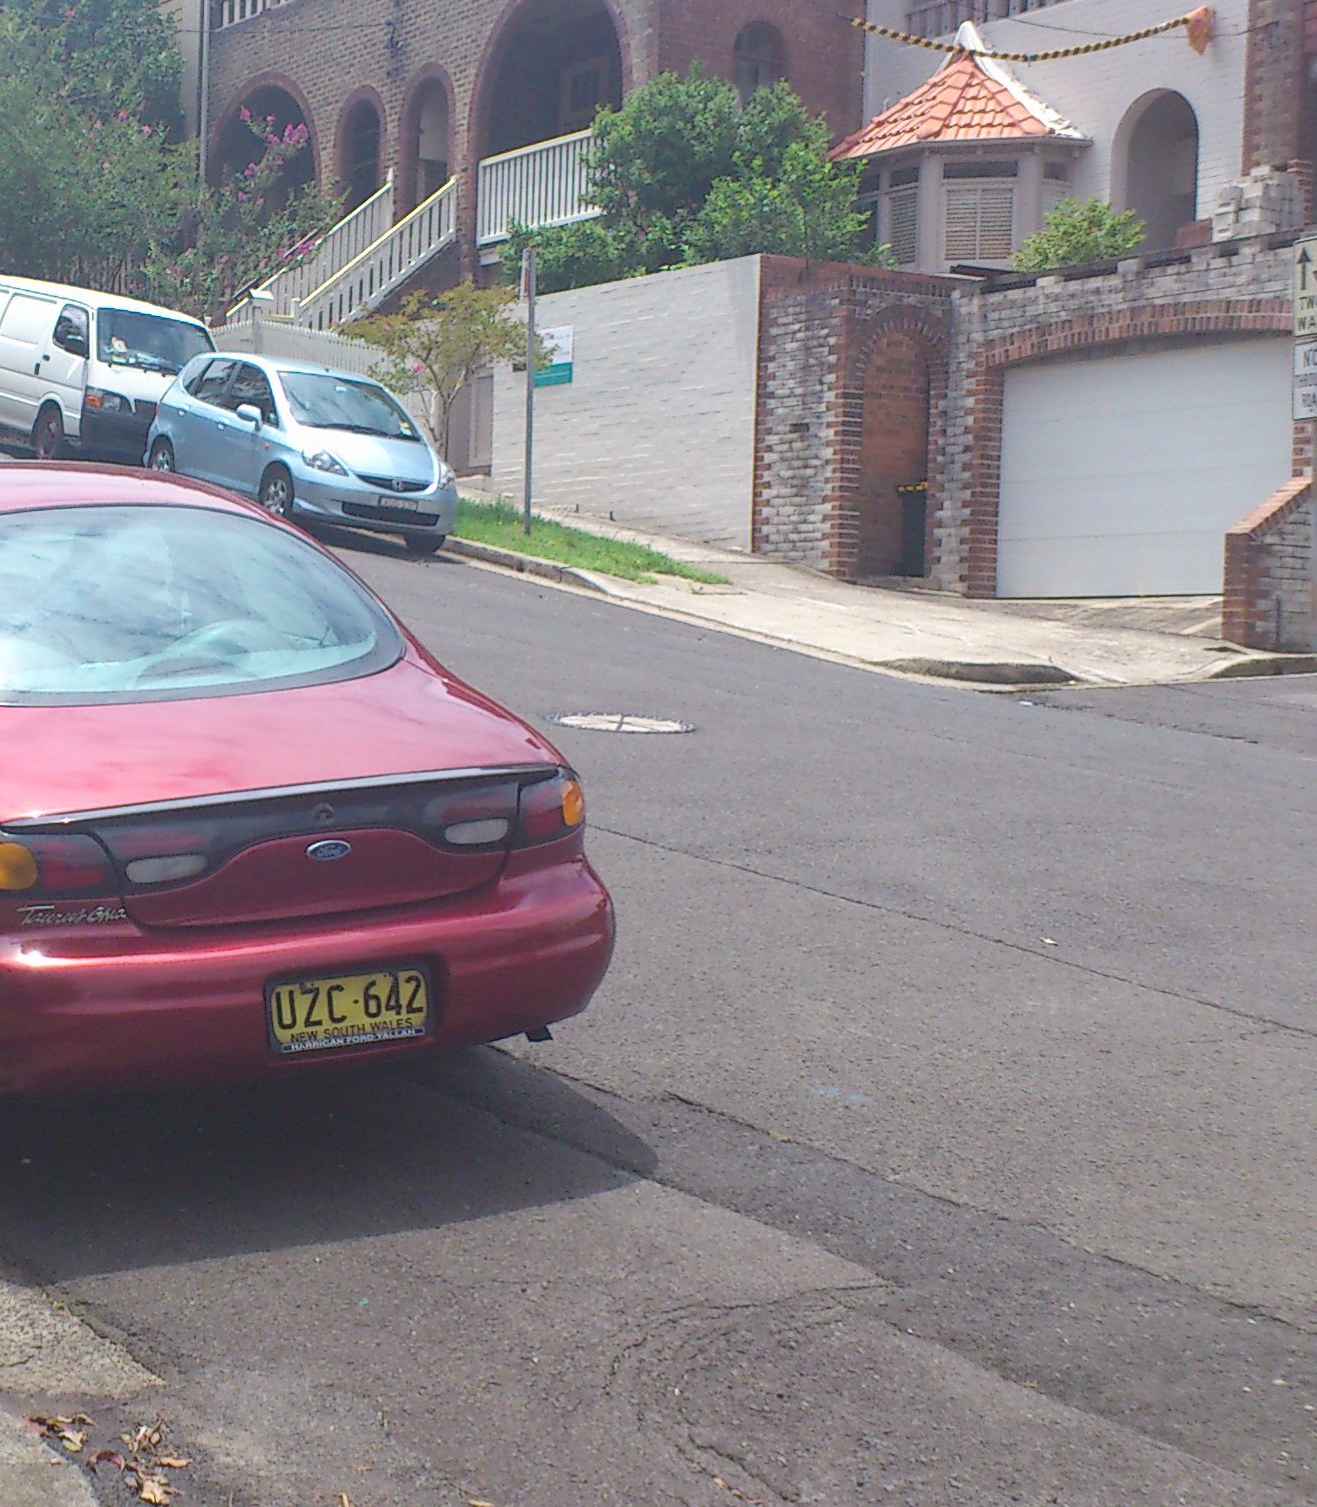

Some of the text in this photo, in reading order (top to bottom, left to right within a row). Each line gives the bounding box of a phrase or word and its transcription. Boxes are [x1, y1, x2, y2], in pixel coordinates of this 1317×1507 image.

[1299, 295, 1317, 311] TW
[1297, 315, 1317, 331] WA
[290, 1016, 414, 1043] NEW SOUTH WALES
